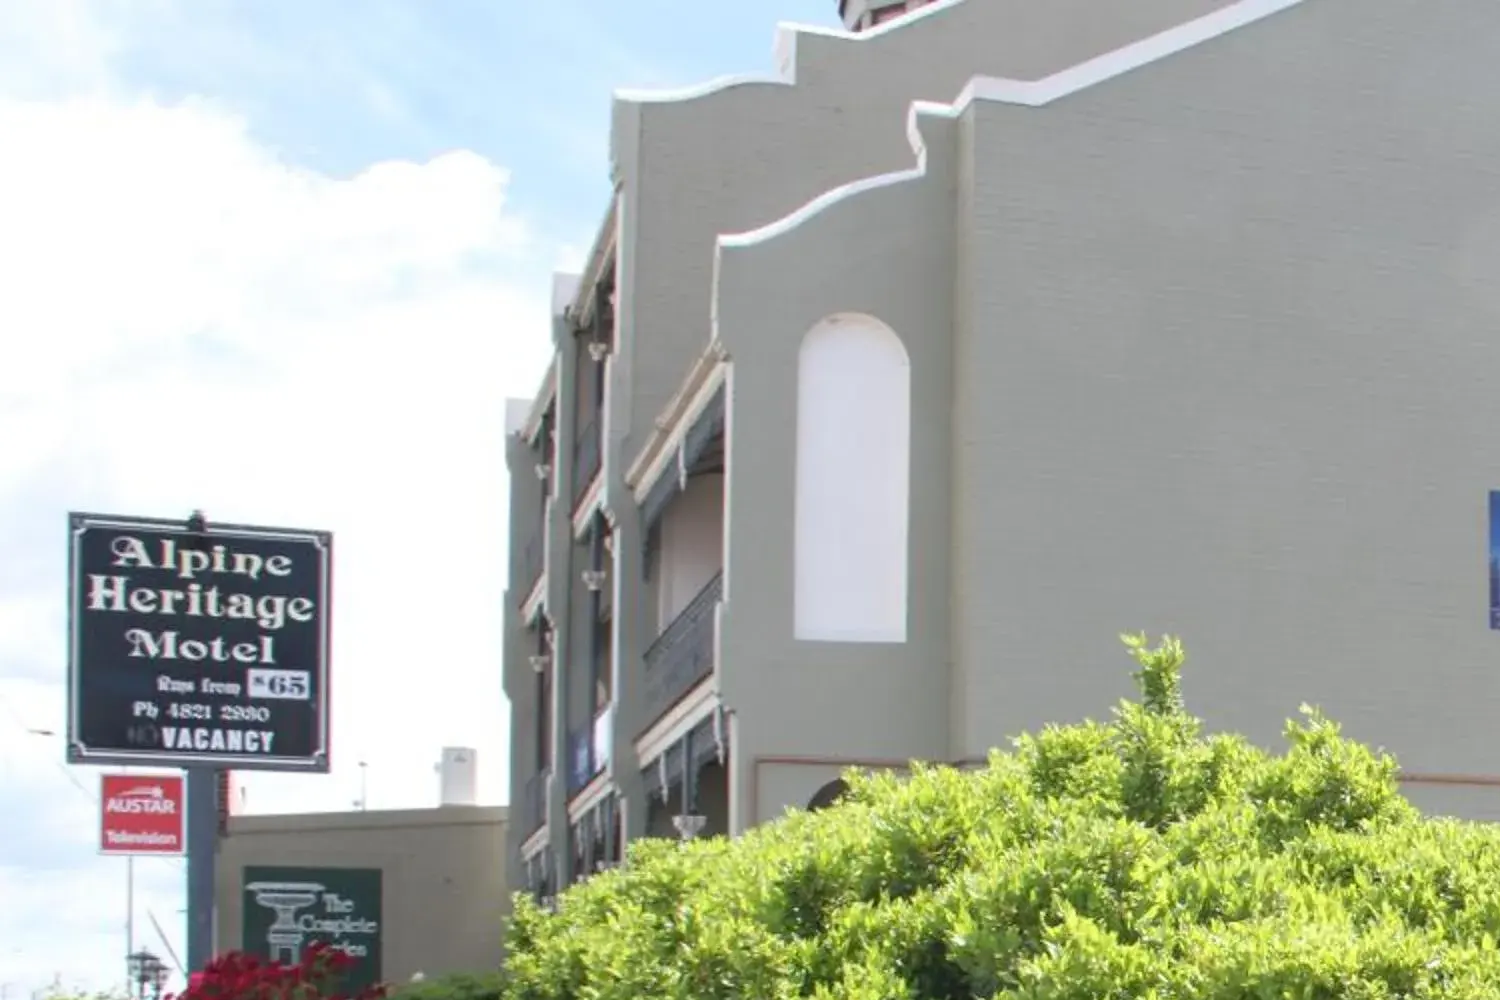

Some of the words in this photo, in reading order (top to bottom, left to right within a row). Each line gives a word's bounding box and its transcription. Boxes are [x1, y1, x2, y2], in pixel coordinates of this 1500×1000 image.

[111, 536, 293, 579] Alpine
[87, 573, 316, 629] Heritage
[124, 628, 277, 664] Motel
[201, 678, 241, 697] from
[252, 673, 306, 696] $65
[132, 701, 159, 719] Ph
[166, 703, 212, 720] 4821
[161, 727, 275, 752] VACANCY
[106, 798, 176, 813] AUSTAR
[106, 830, 177, 845] Television
[322, 893, 353, 912] The
[300, 914, 377, 938] Complete
